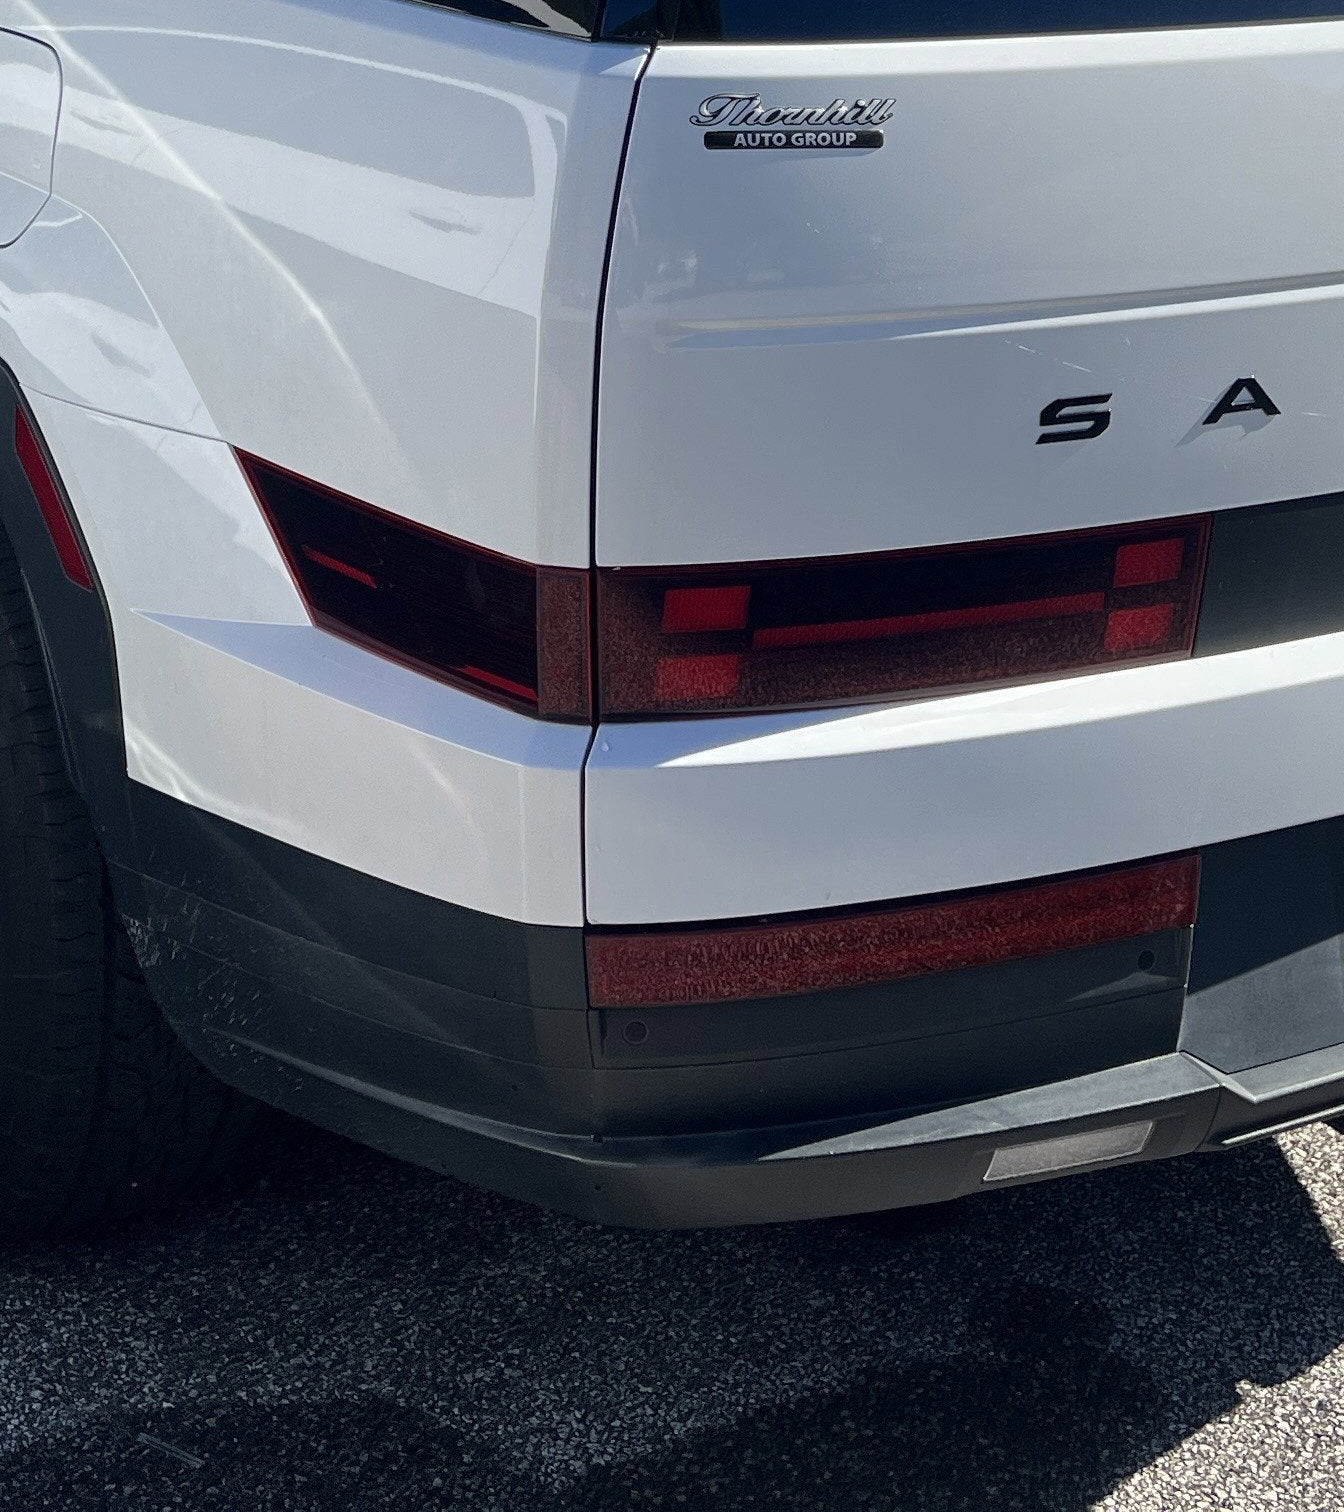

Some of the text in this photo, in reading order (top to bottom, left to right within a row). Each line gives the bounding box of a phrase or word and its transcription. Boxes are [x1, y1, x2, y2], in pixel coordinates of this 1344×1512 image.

[689, 92, 897, 126] Thornhill
[734, 131, 858, 147] AUTO GROUP
